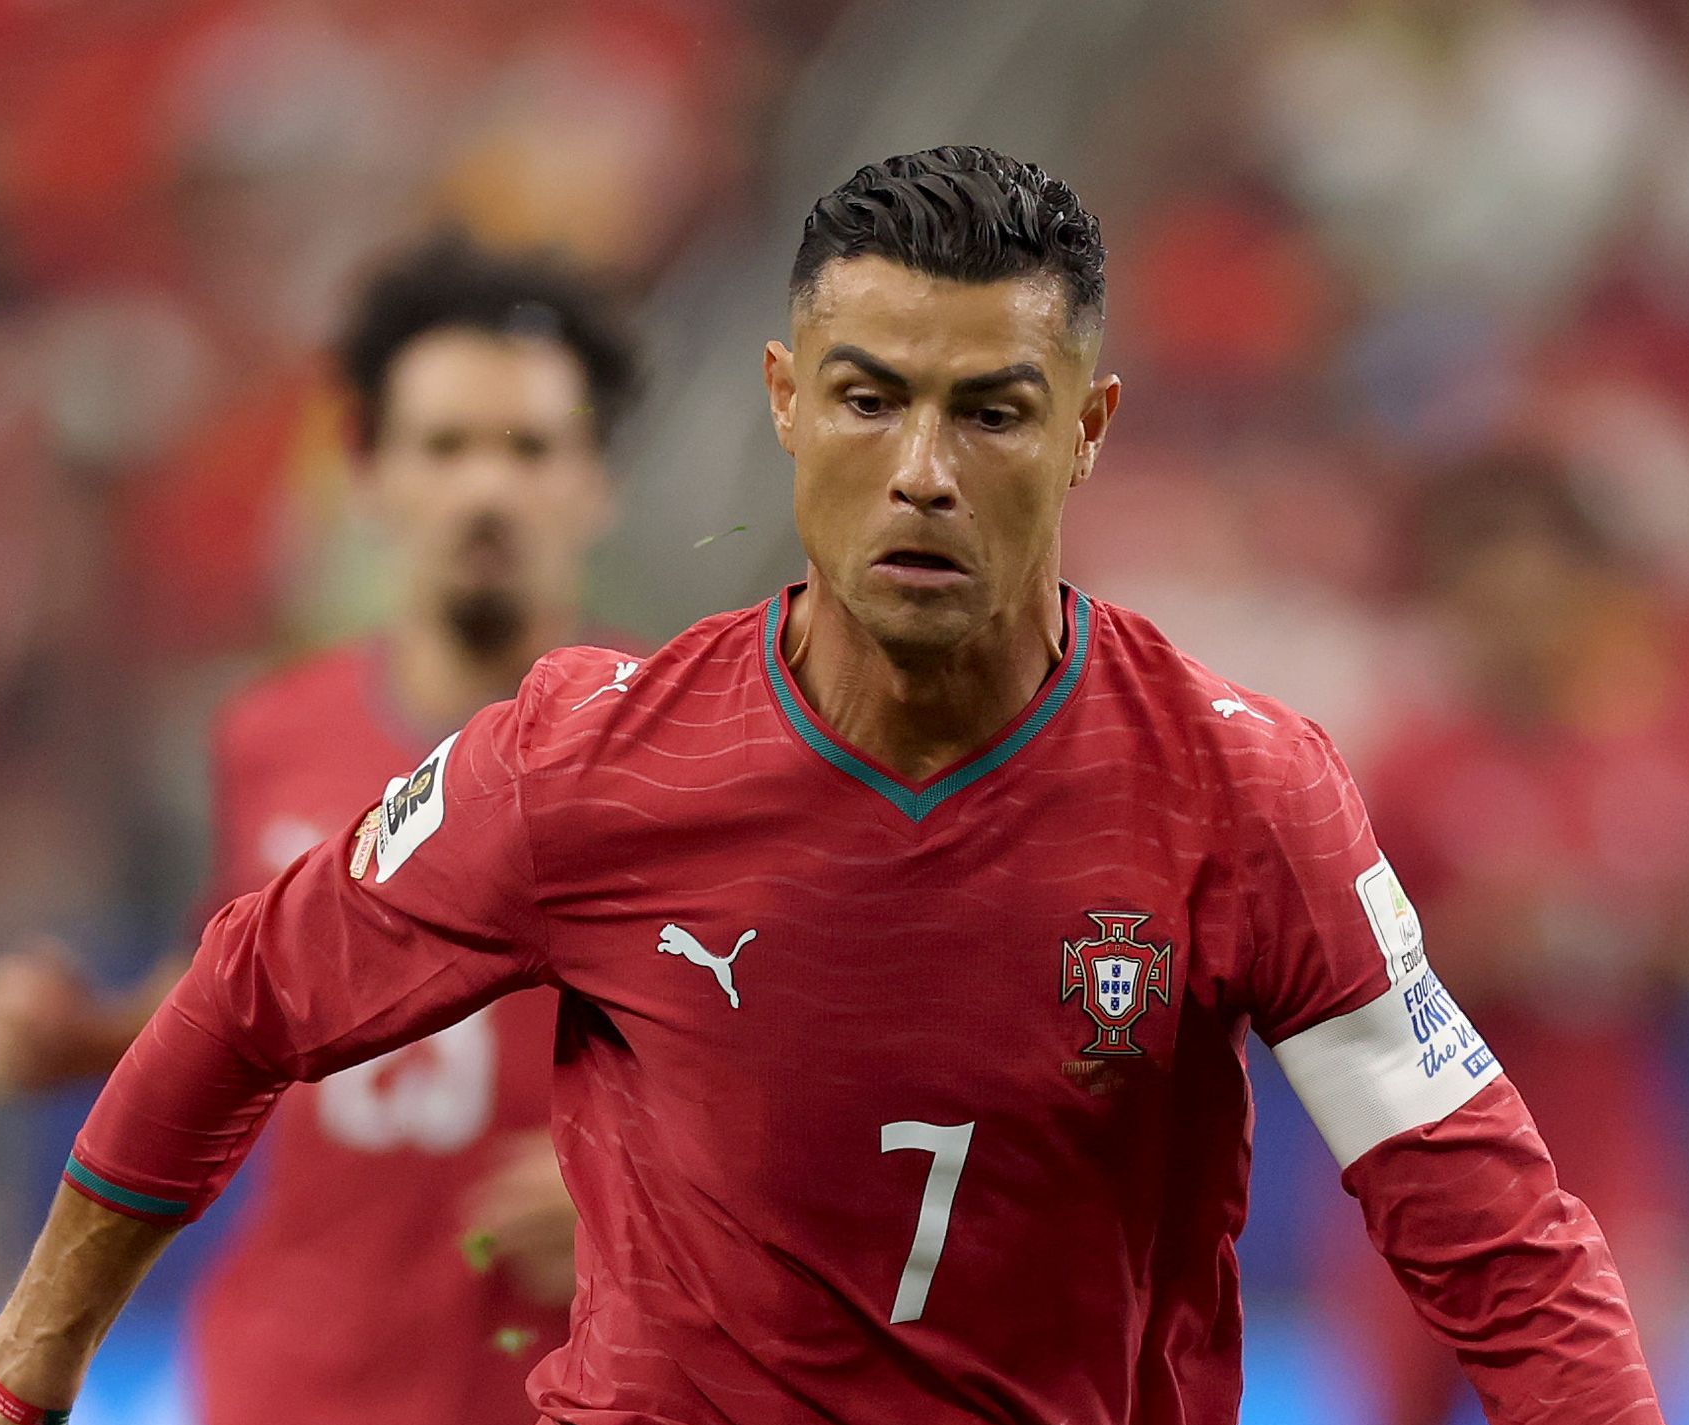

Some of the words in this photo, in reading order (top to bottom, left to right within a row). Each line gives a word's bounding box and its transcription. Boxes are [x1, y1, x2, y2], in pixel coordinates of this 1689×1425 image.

[1411, 988, 1459, 1044] UNIT
[1417, 1043, 1457, 1078] the
[880, 1120, 975, 1324] 7
